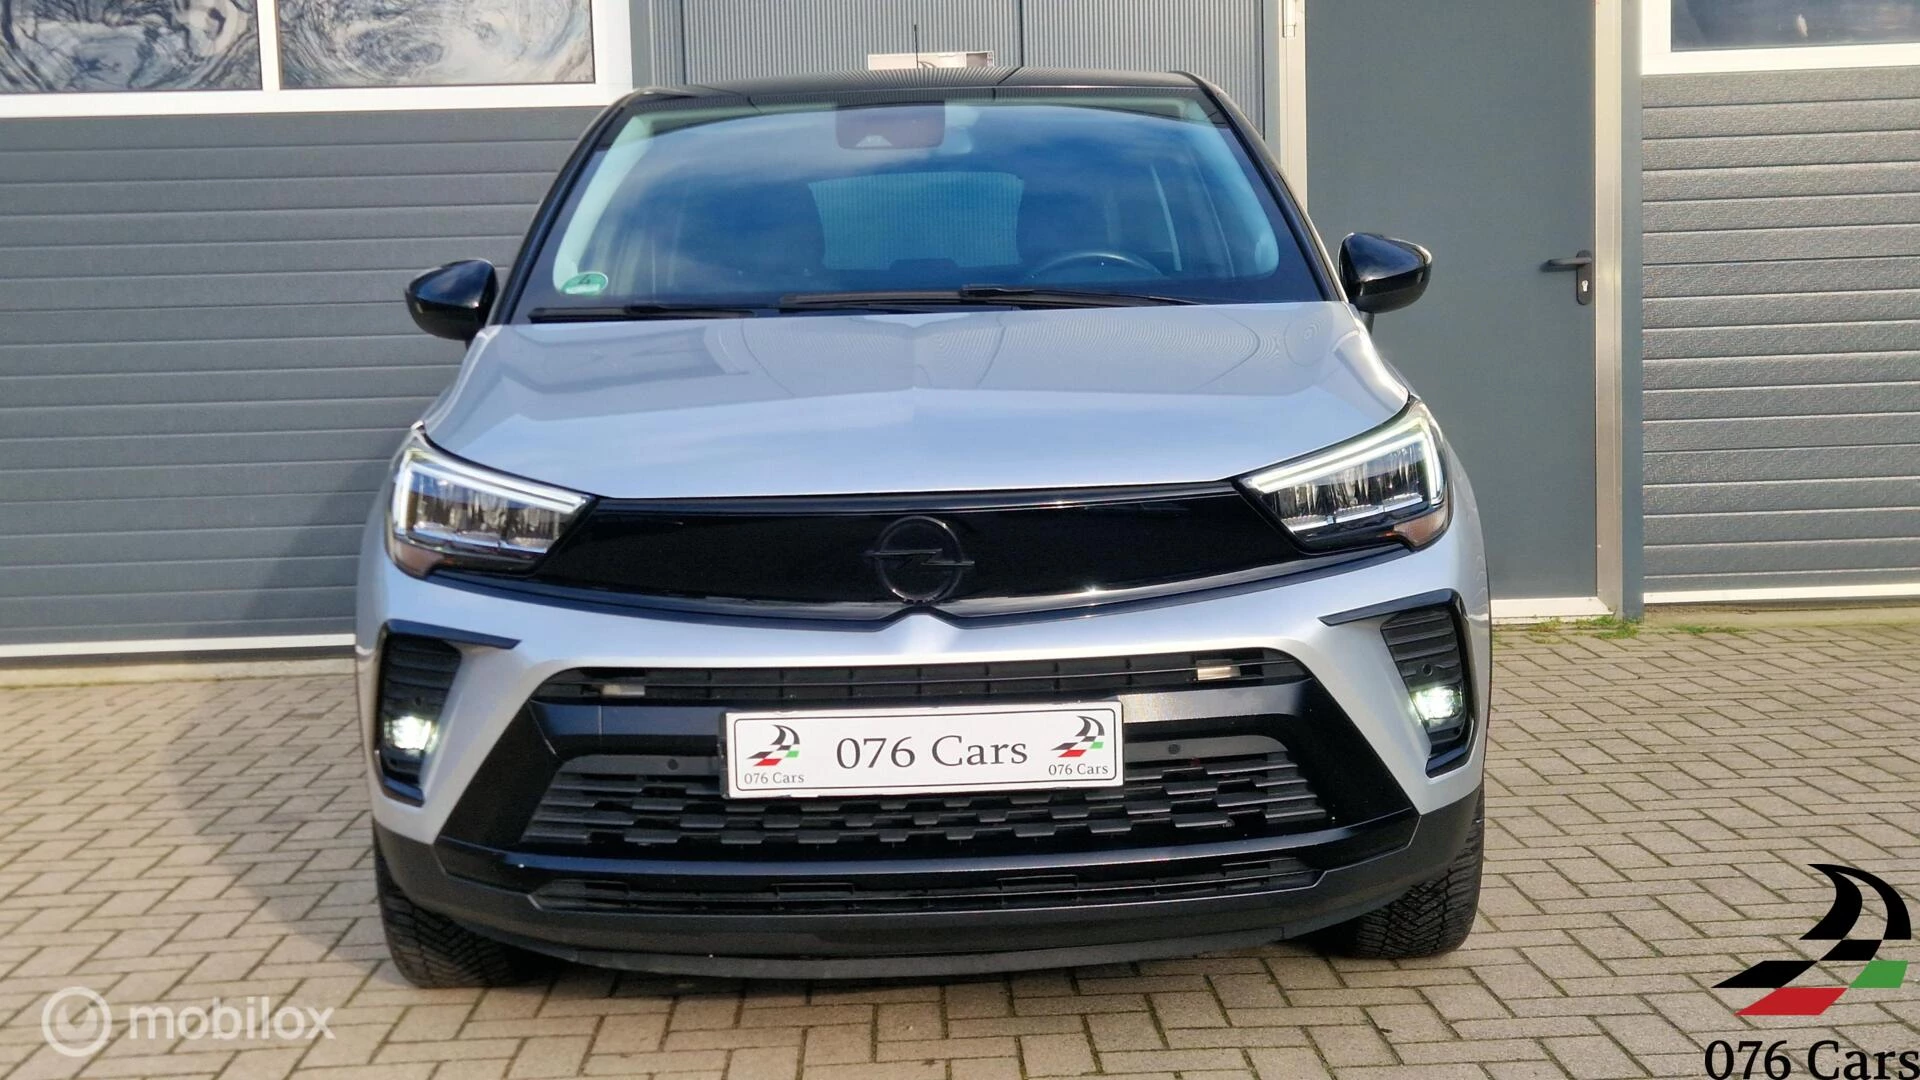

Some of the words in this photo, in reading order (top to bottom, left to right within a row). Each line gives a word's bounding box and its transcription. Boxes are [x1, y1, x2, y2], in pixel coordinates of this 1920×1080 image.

[836, 736, 916, 770] 076
[931, 734, 1028, 767] Cars
[1048, 764, 1073, 776] 076
[1077, 763, 1109, 775] Cars
[744, 772, 769, 785] 076
[772, 771, 805, 784] Cars
